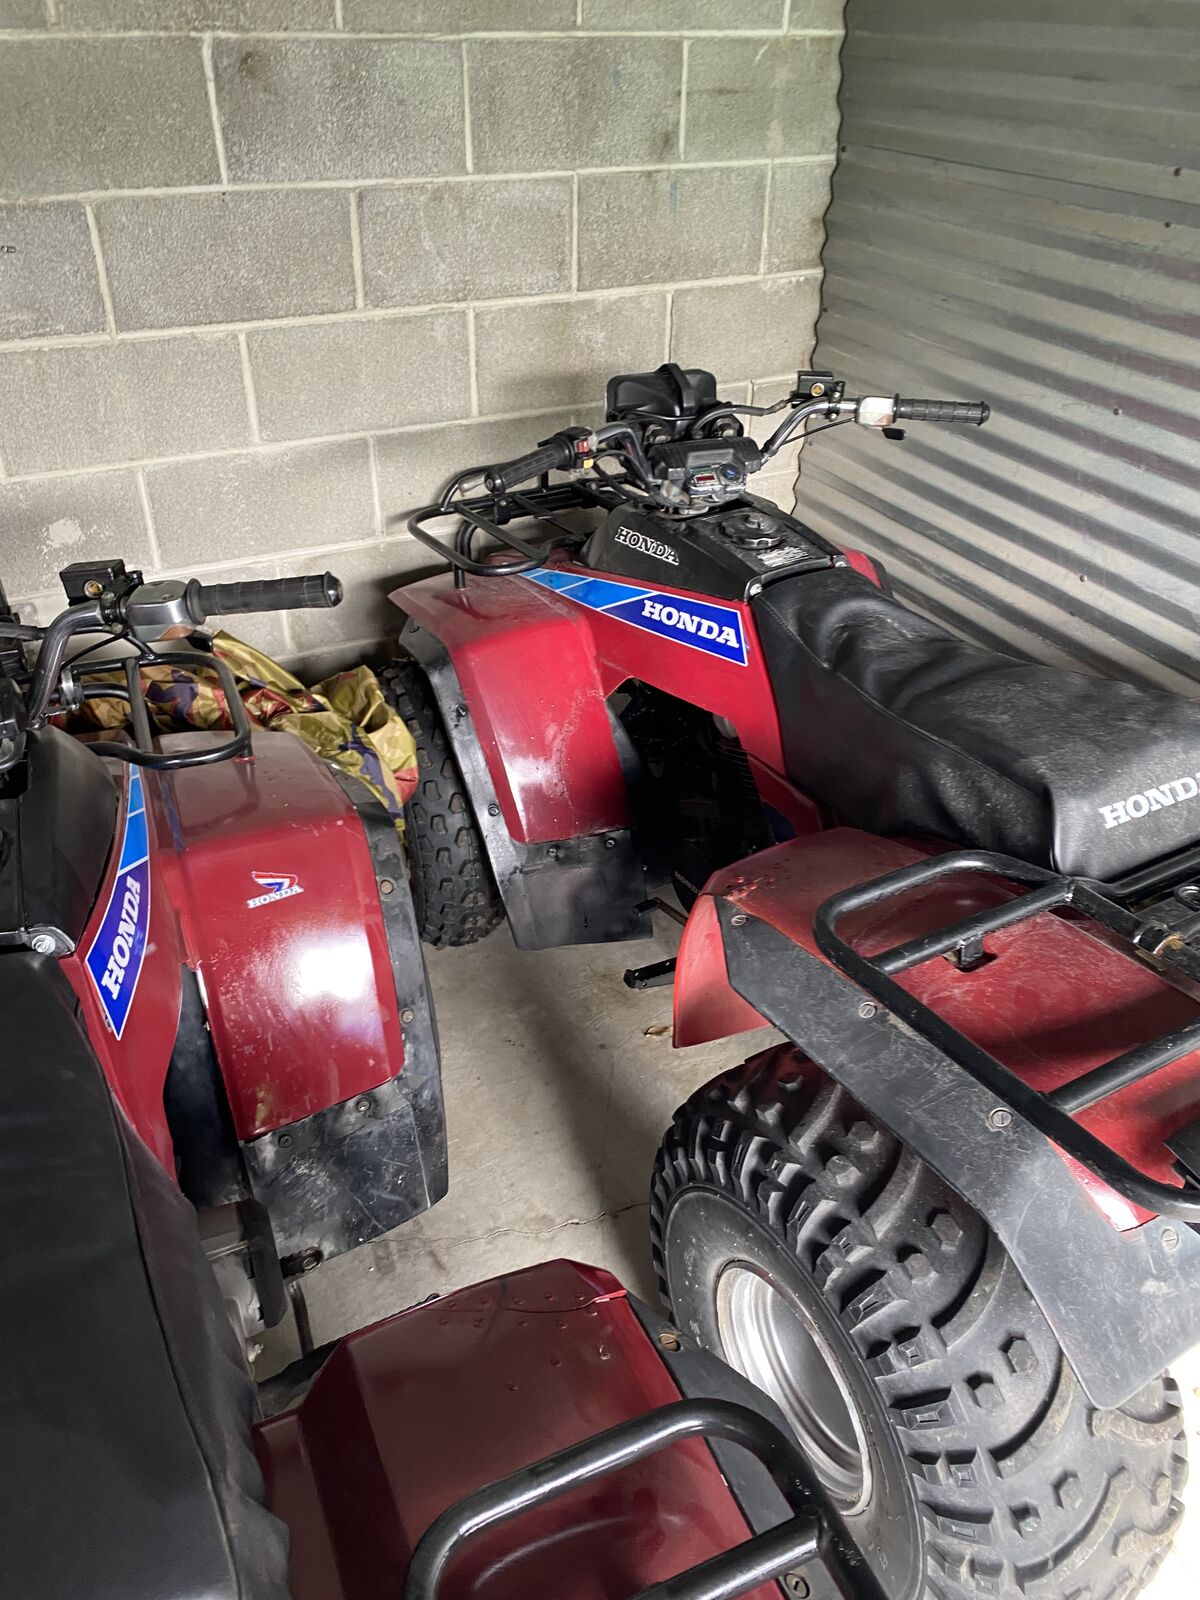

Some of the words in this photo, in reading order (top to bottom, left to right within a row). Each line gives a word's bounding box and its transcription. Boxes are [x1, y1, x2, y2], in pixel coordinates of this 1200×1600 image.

[614, 526, 680, 565] HONDA
[642, 599, 739, 648] HONDA
[246, 885, 304, 909] HONDA
[101, 876, 141, 1000] HONDA
